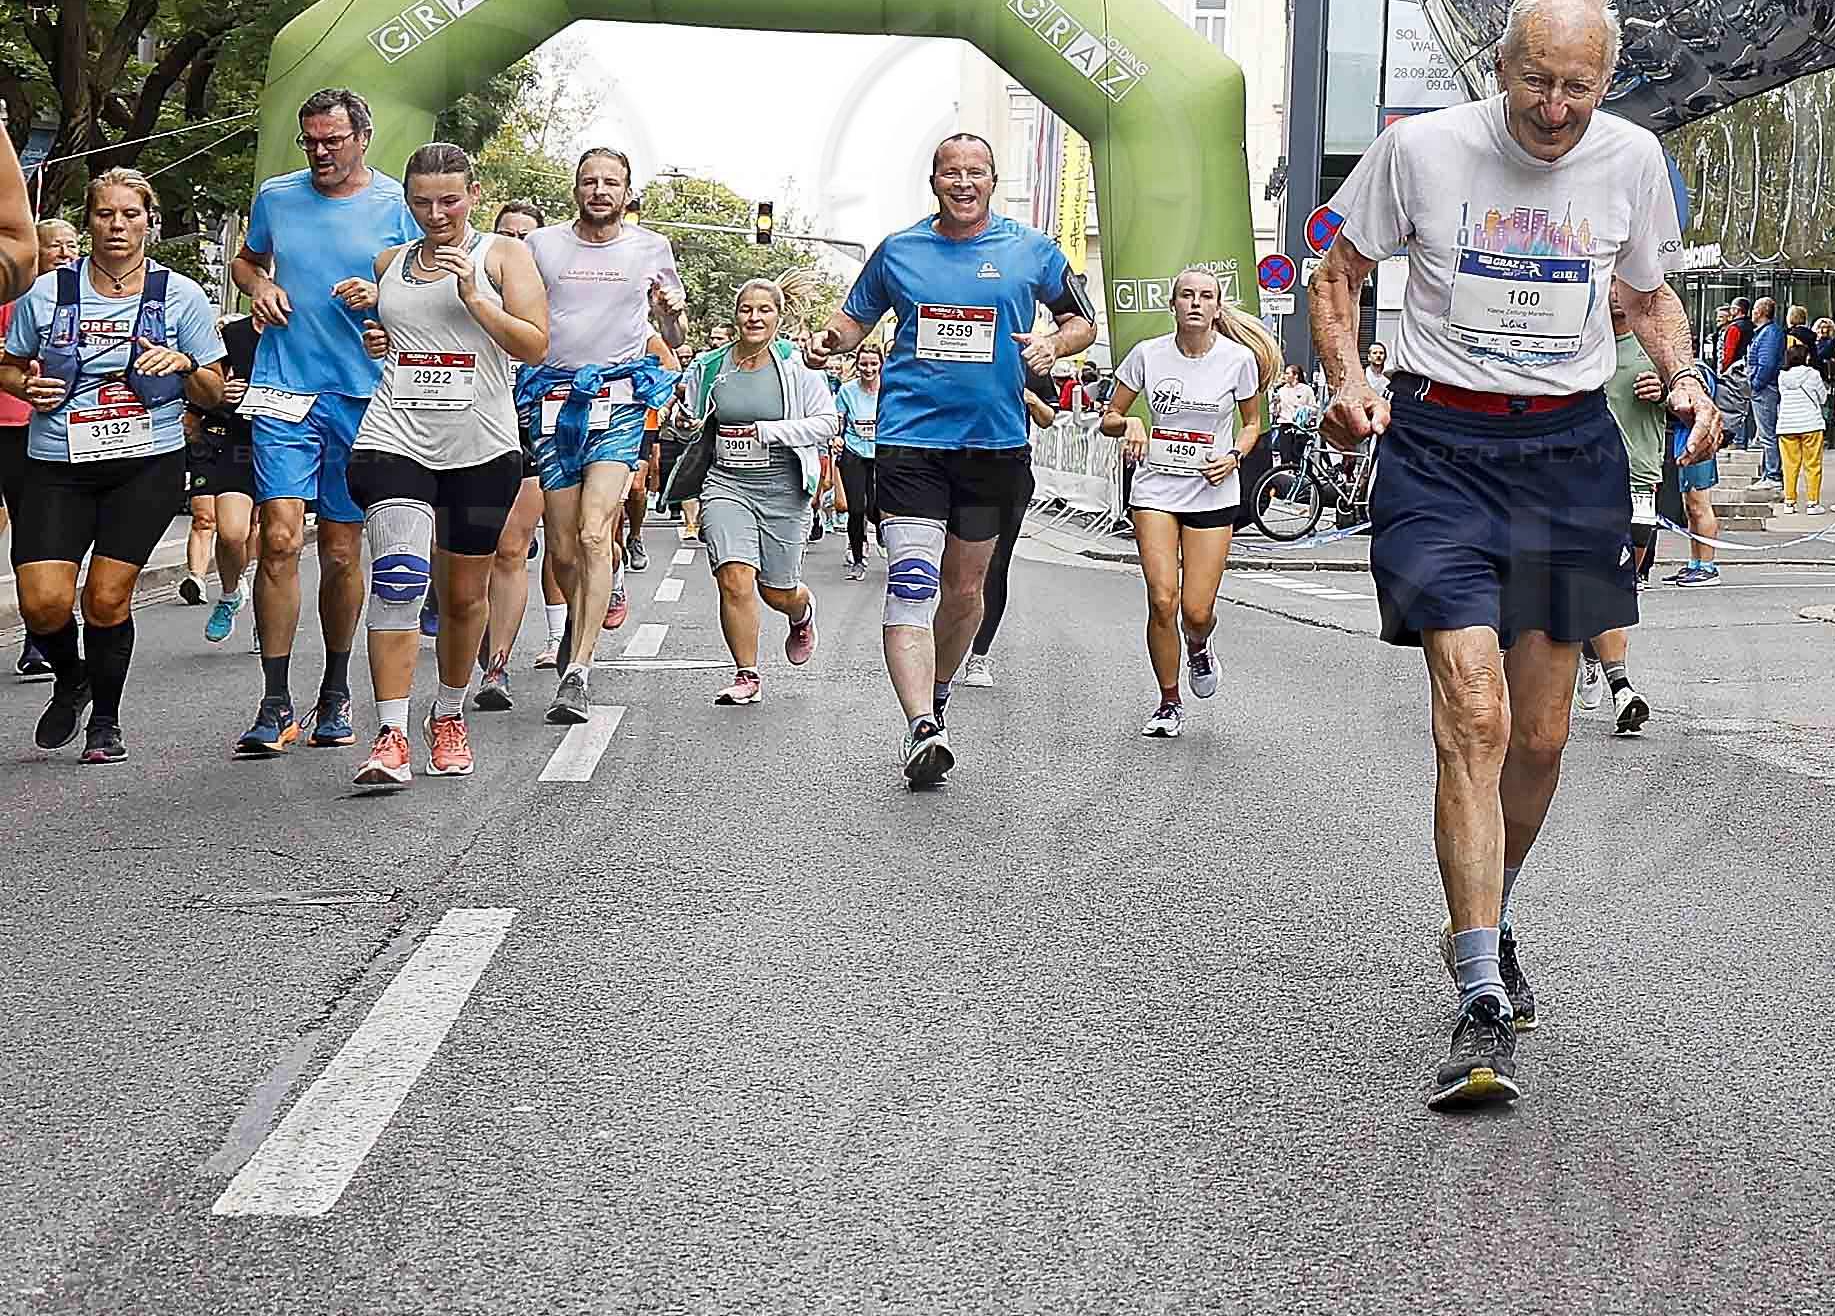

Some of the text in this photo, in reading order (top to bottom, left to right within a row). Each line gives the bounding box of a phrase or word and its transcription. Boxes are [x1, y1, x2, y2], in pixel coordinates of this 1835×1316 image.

[1395, 28, 1421, 40] SOL
[1411, 41, 1437, 52] WAL
[1393, 67, 1453, 79] 28.09.202
[1680, 240, 1722, 269] elcome
[1507, 290, 1540, 306] 100
[936, 323, 973, 338] 2559
[412, 369, 453, 385] 2922
[90, 421, 131, 438] 3132
[724, 439, 752, 451] 3901
[1165, 443, 1197, 458] 4450
